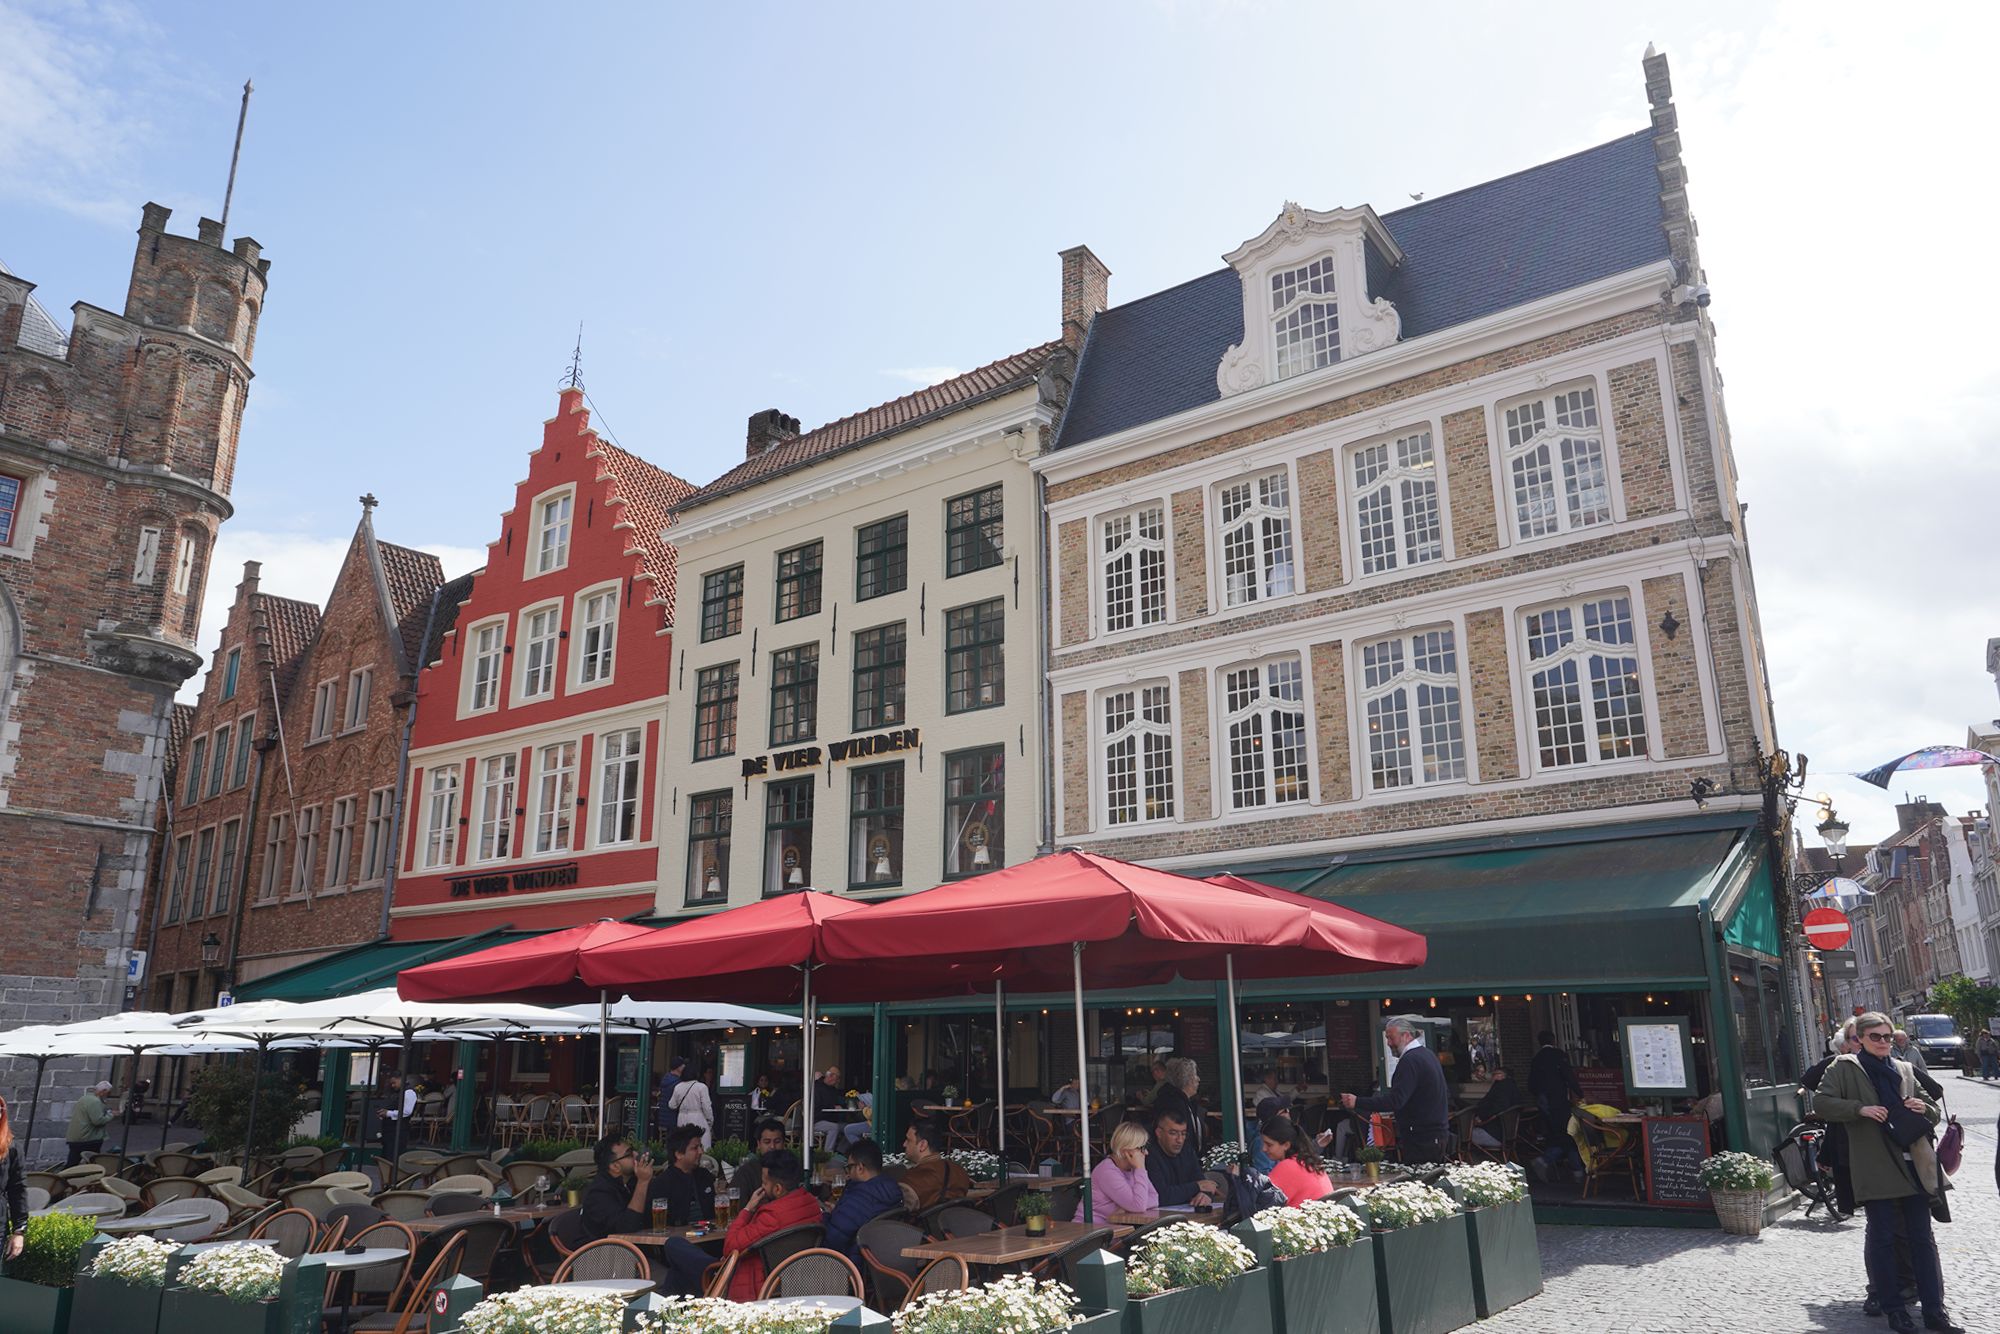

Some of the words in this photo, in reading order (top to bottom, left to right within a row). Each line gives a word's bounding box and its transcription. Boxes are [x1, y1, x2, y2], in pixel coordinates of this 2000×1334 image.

[742, 756, 768, 777] DE
[772, 746, 822, 771] VIER
[828, 728, 920, 762] WINDEN
[451, 879, 470, 897] DE
[474, 876, 509, 894] VIER
[512, 867, 578, 890] WINDEN
[624, 1099, 638, 1108] PIZZ
